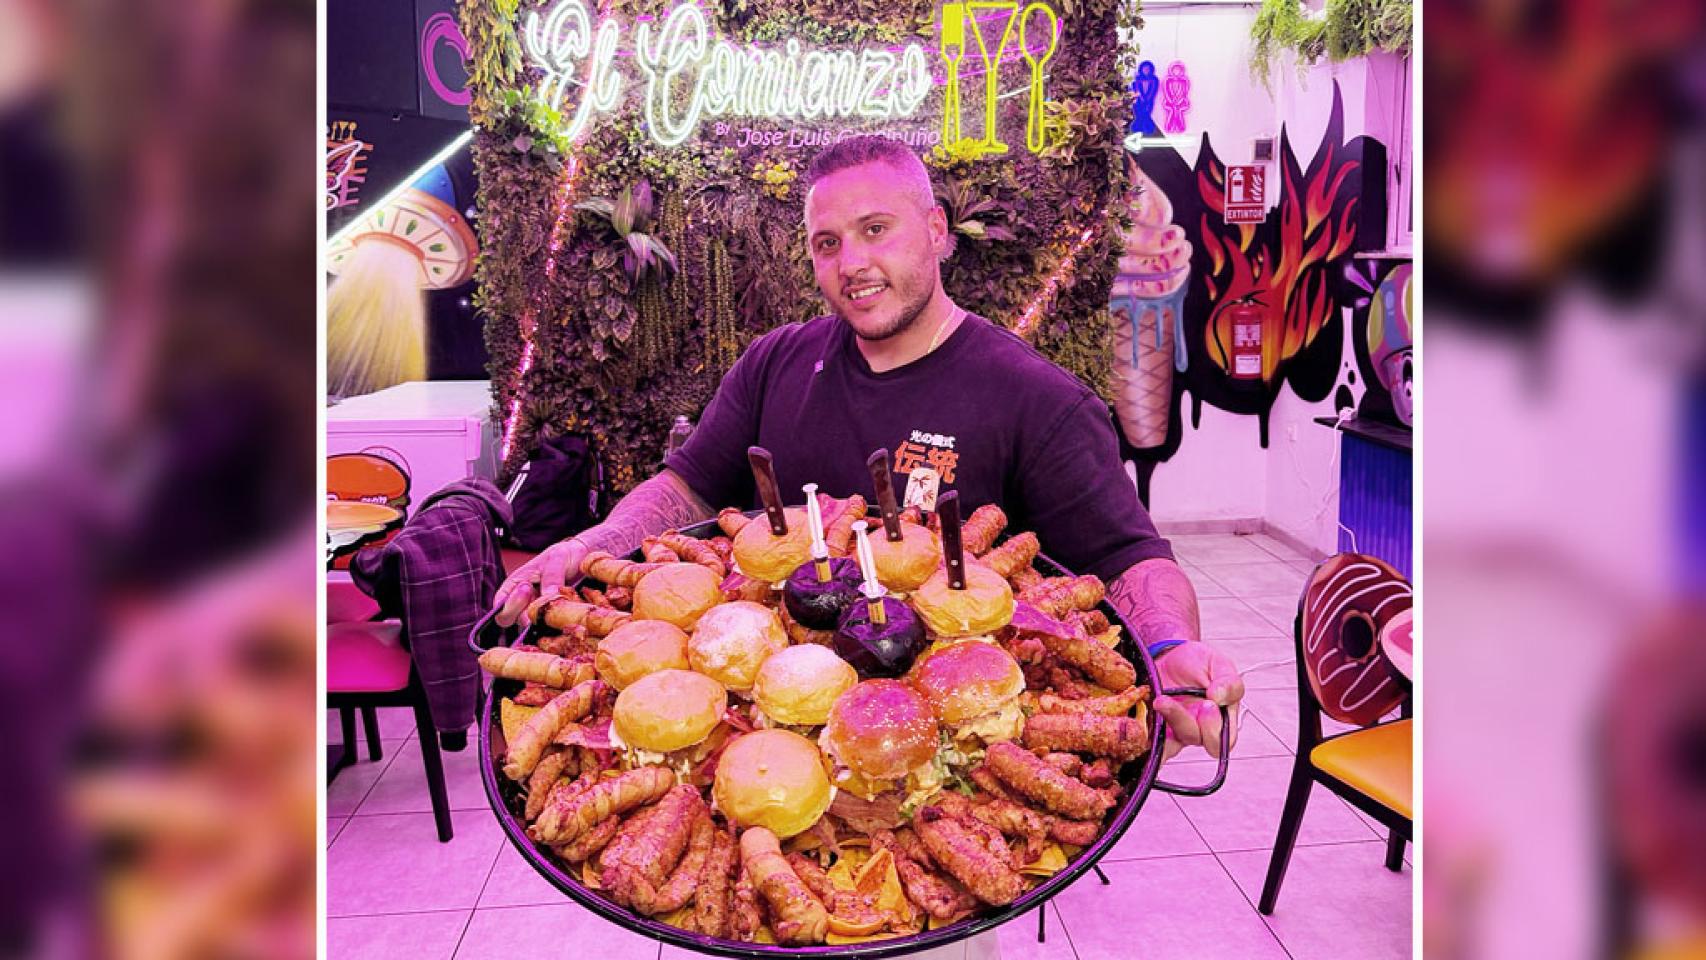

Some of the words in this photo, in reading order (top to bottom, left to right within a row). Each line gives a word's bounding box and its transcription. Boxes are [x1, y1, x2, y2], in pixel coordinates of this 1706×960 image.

[525, 0, 620, 142] El
[637, 3, 932, 146] Comienzo
[736, 128, 784, 148] Jose
[787, 127, 831, 148] Luis
[836, 126, 940, 146] Gipuño
[1227, 209, 1265, 219] EXTINTOR
